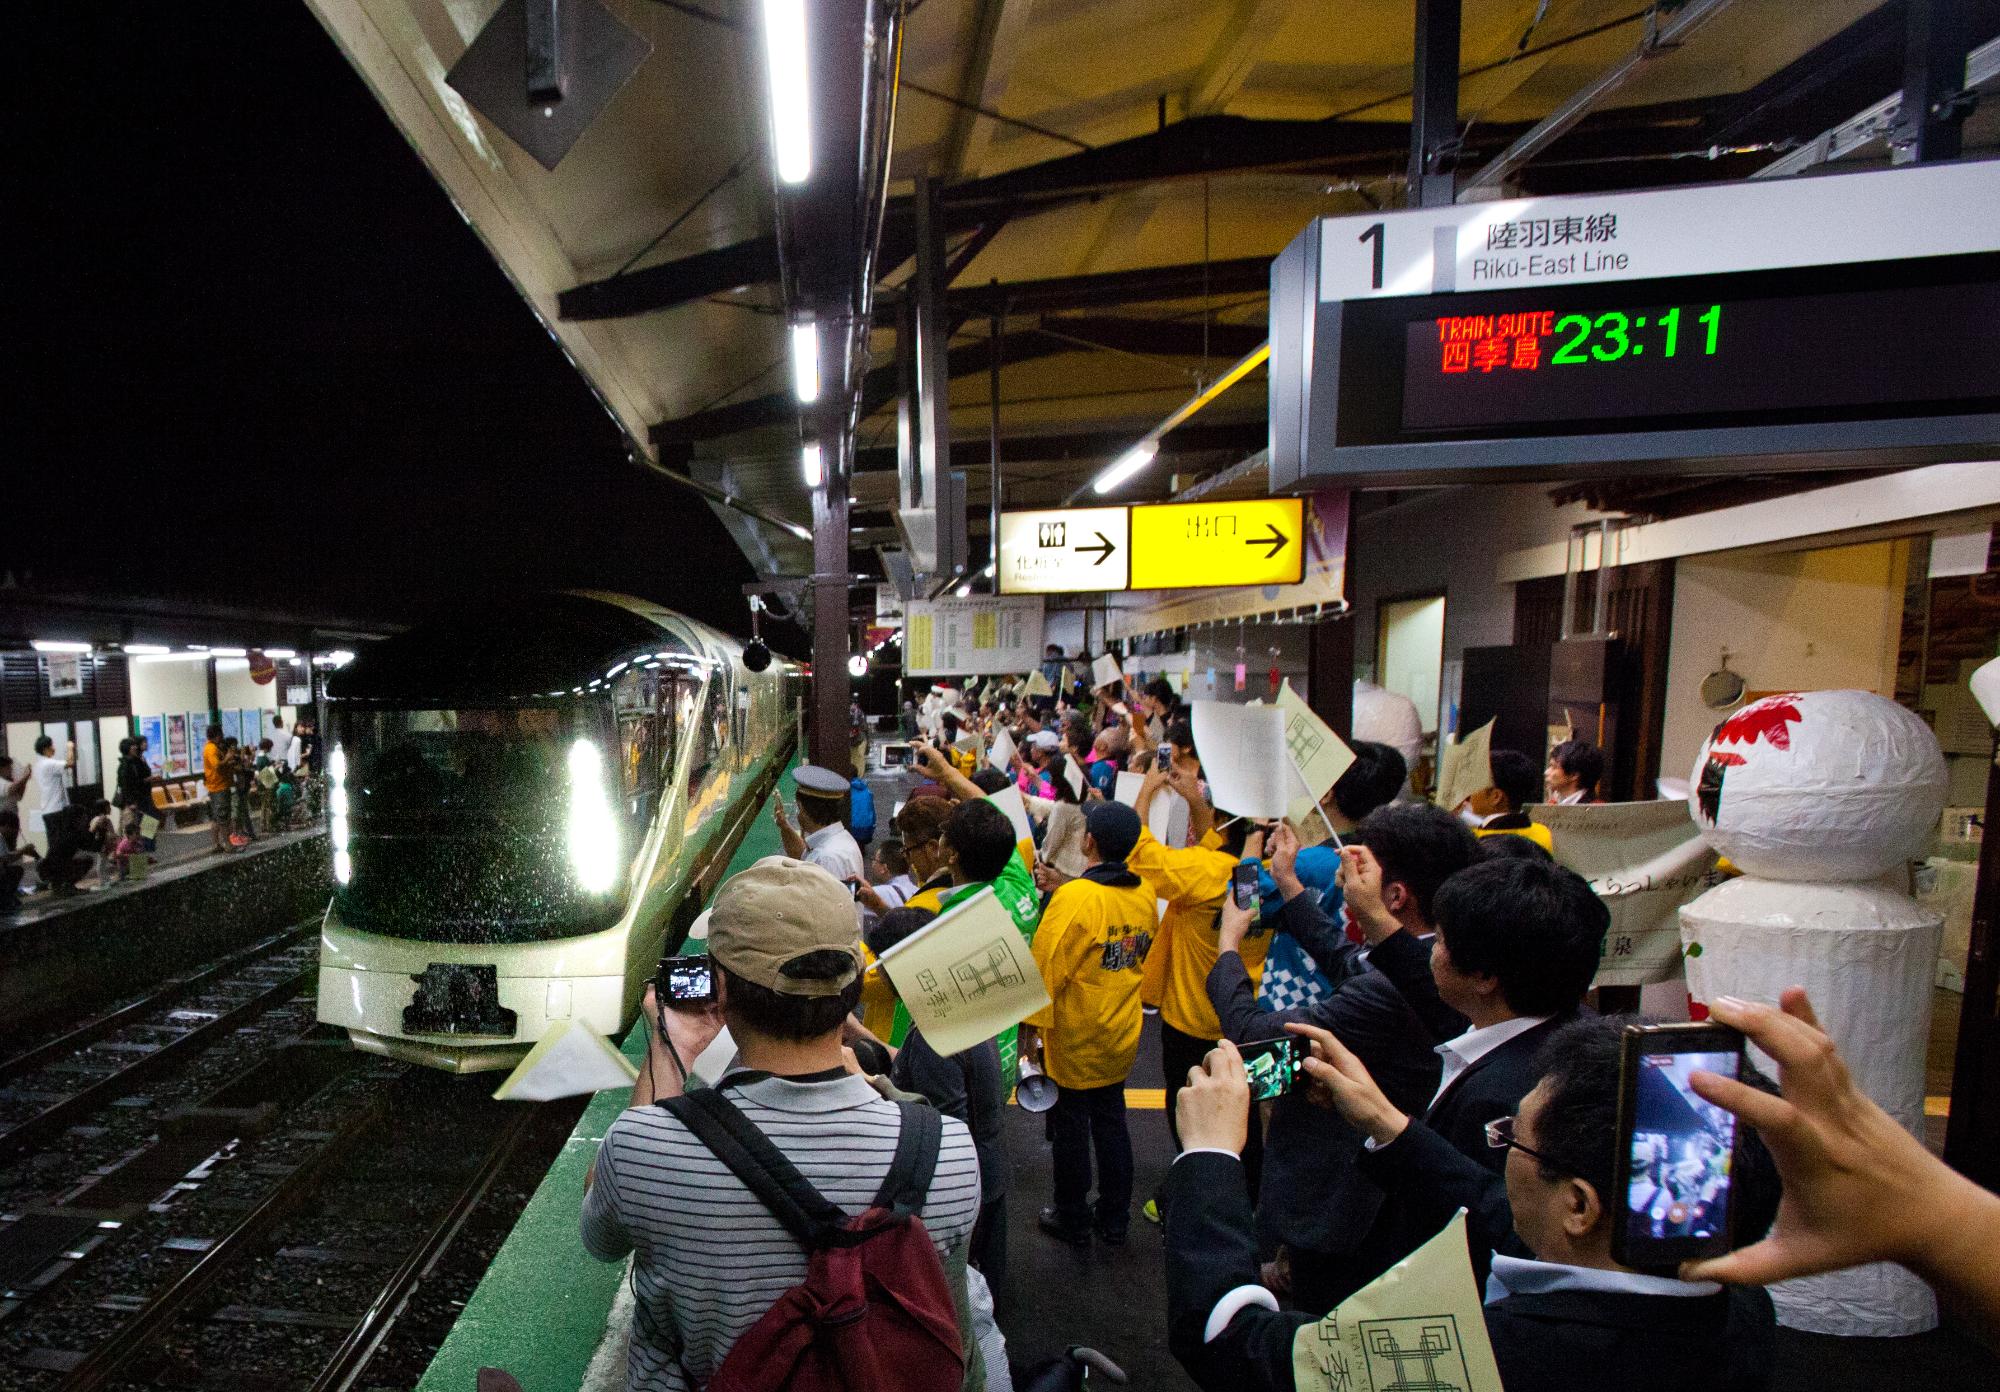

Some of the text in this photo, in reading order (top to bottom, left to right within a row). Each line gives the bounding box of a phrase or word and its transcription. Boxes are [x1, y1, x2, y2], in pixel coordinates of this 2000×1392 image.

[1487, 213, 1618, 251] 陸羽東線
[1358, 222, 1385, 289] 1
[1583, 250, 1630, 273] Line
[1436, 310, 1555, 342] TRAIN SUITE
[1551, 304, 1722, 365] 23:11
[1441, 333, 1542, 373] 四季島
